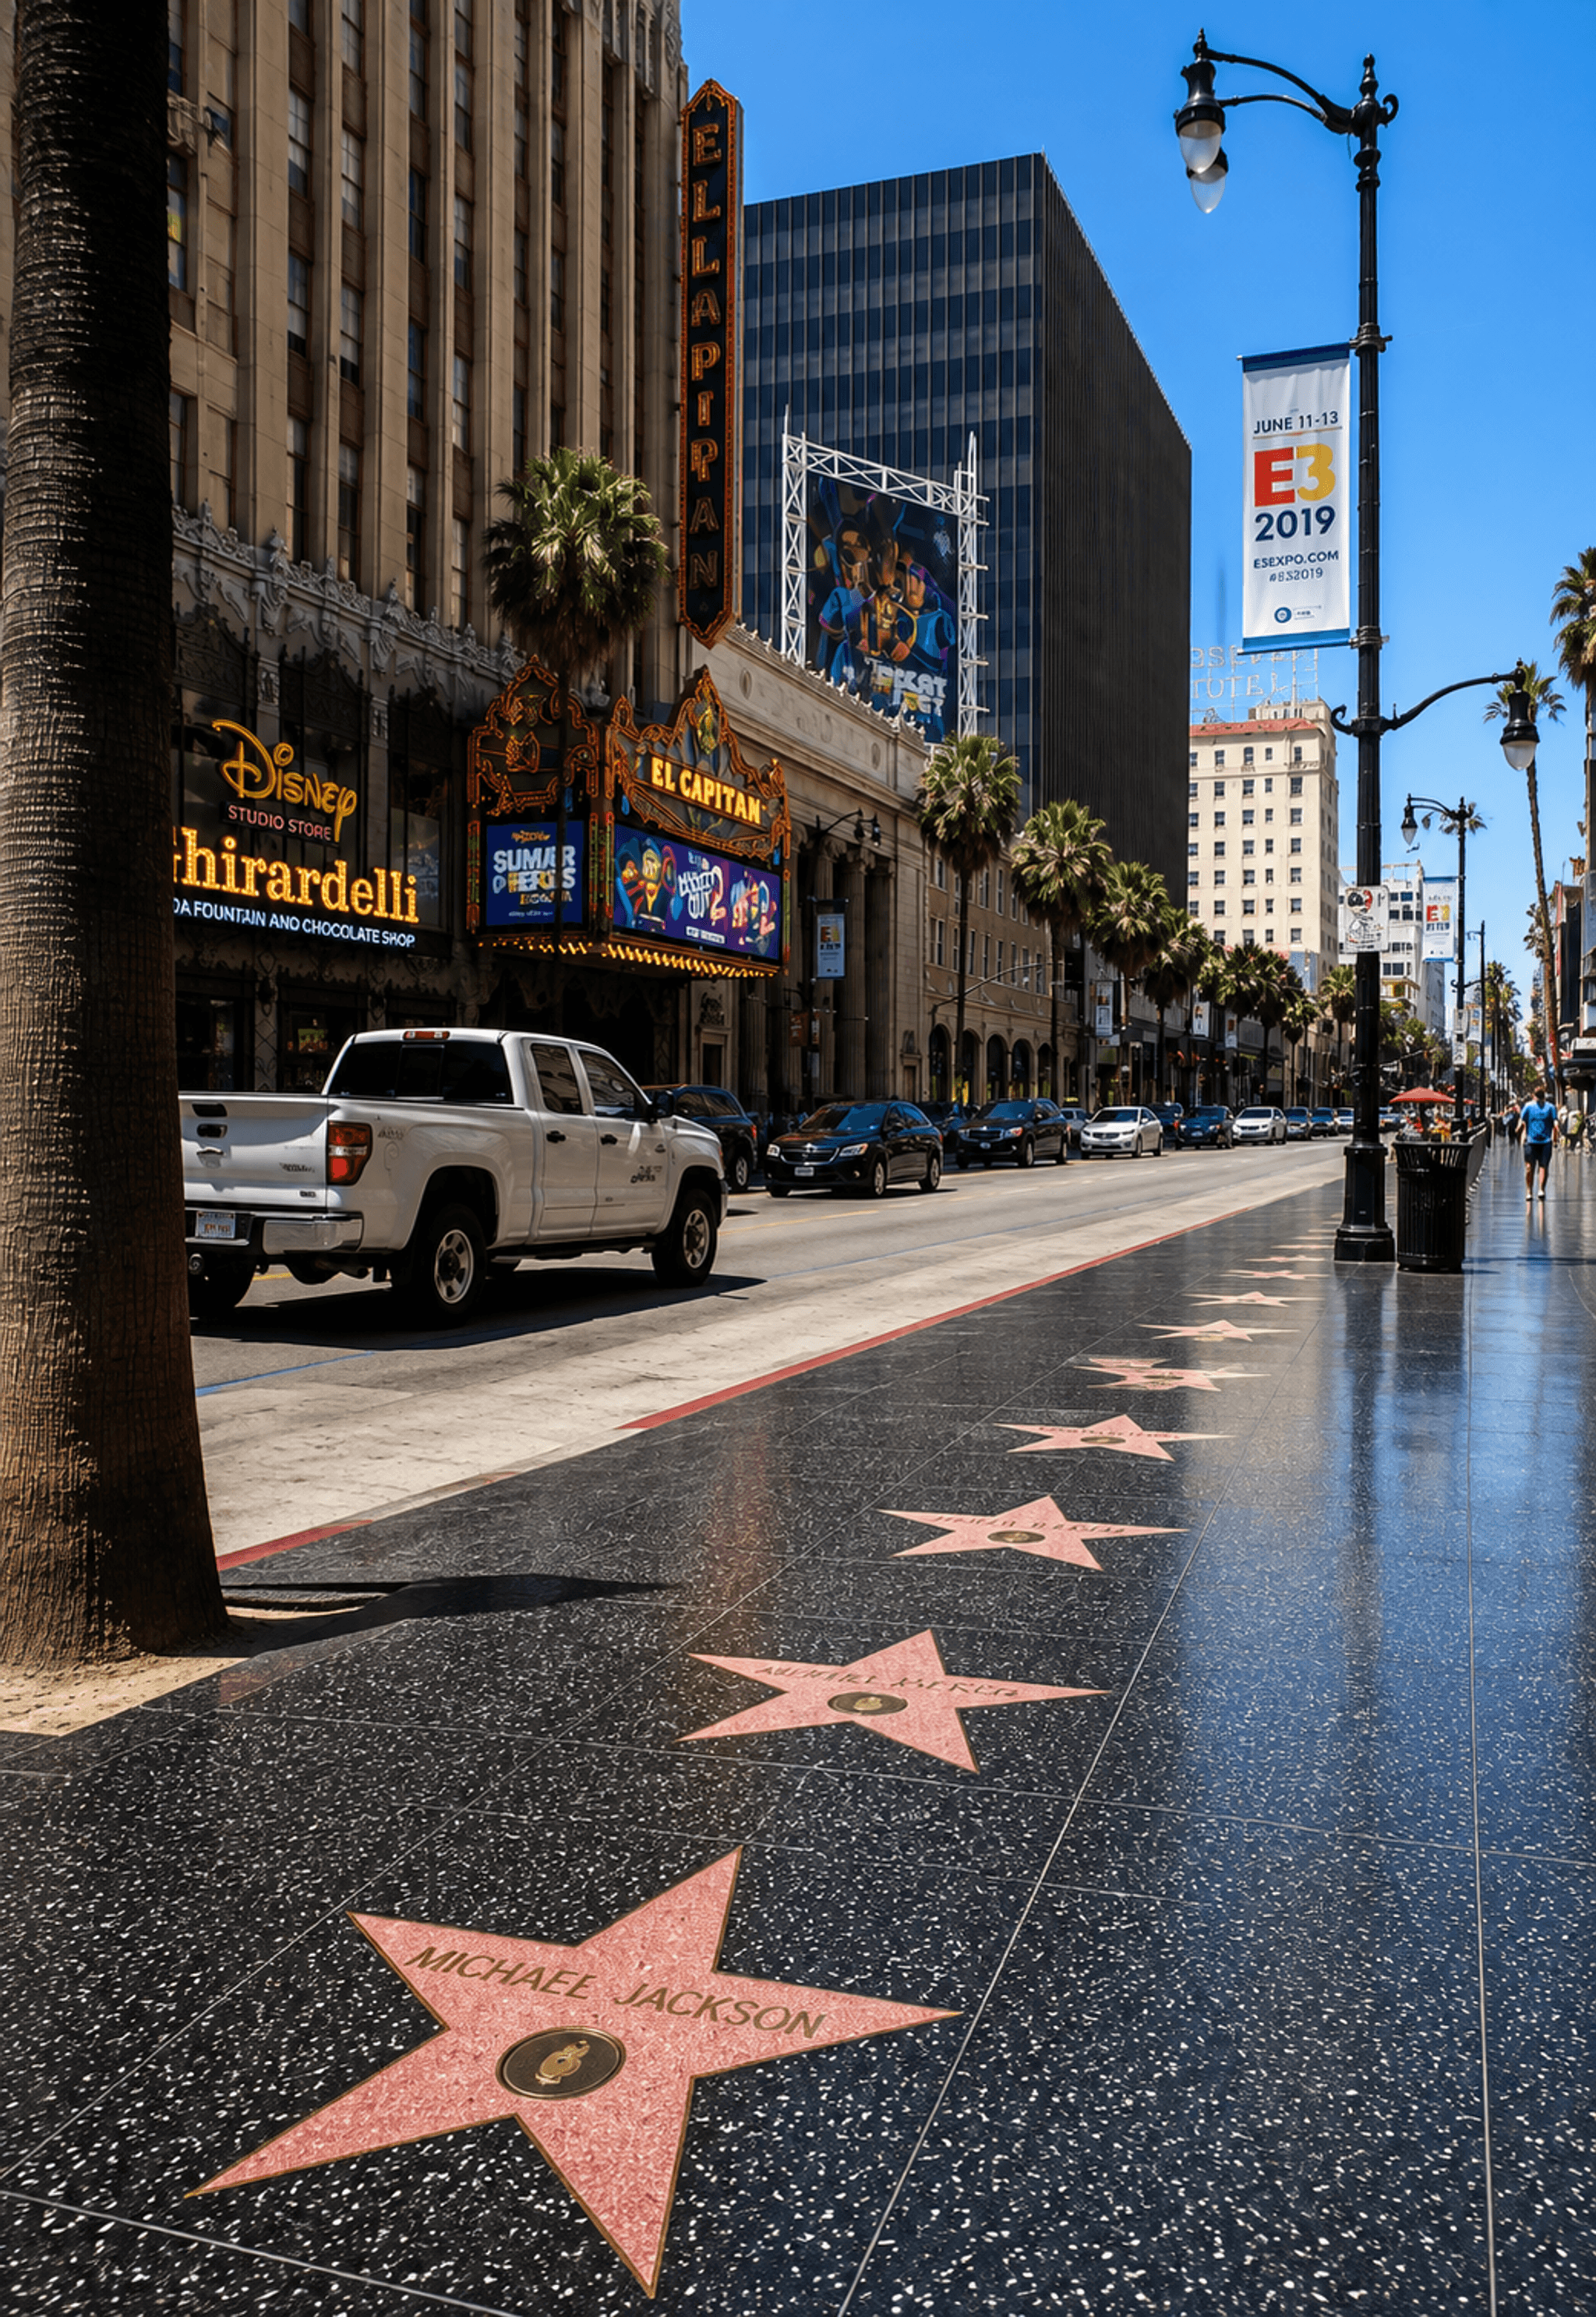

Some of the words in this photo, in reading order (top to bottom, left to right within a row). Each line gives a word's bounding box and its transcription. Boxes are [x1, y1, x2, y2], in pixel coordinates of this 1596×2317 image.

[1254, 417, 1293, 434] JUNE
[1298, 411, 1338, 429] 11-13
[1254, 443, 1336, 507] E3
[1255, 505, 1336, 542] 2019
[651, 757, 676, 793] EL
[680, 768, 761, 825] CAPITAN
[228, 804, 284, 830] STUDIO
[194, 900, 267, 927] FOUNTAIN
[302, 918, 380, 944] CHOCOLATE
[382, 931, 415, 948] SHOP
[614, 1983, 827, 2039] JACKSON
